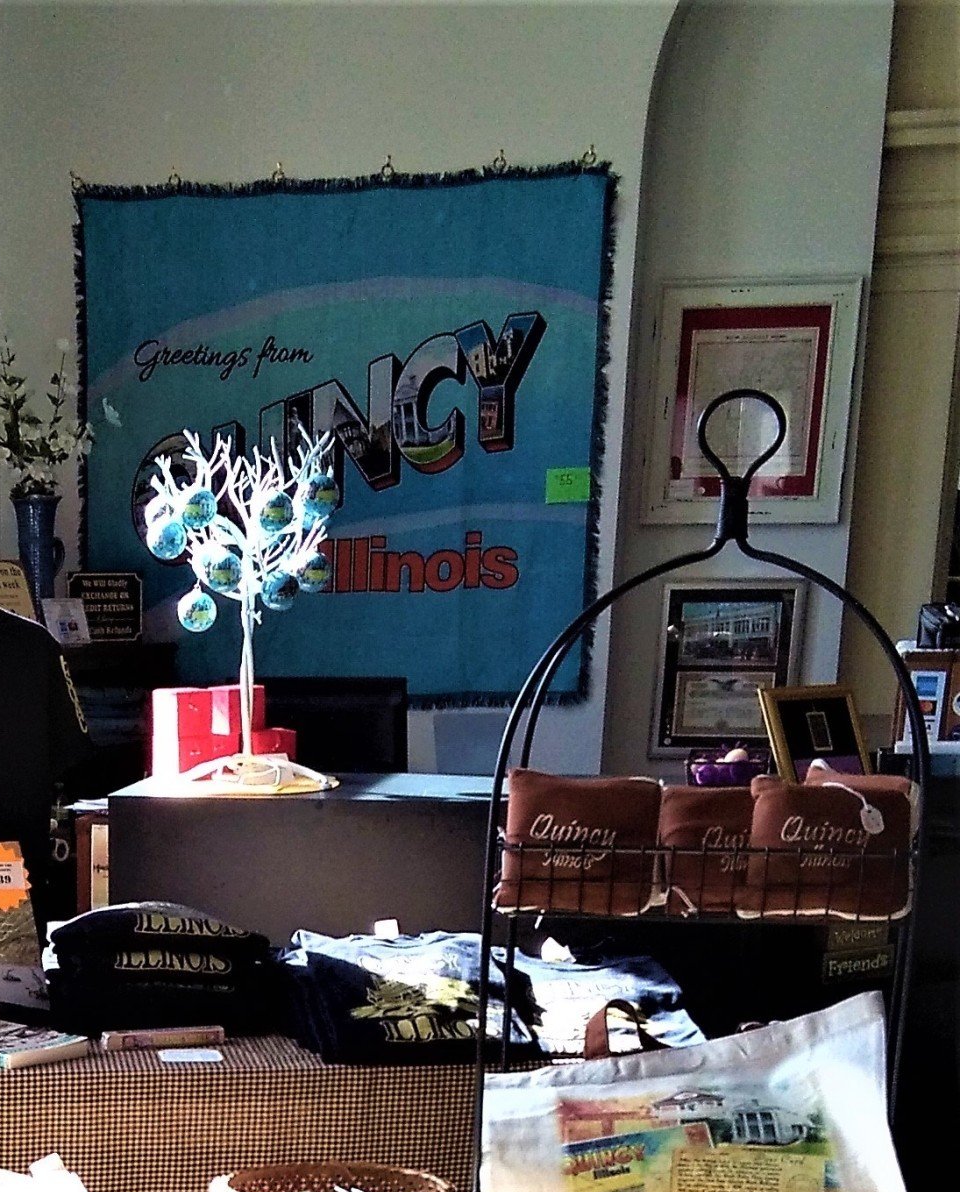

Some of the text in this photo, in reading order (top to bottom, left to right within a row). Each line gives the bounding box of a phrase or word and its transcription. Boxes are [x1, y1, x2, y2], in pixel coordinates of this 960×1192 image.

[134, 335, 314, 383] Greetings from
[84, 604, 102, 612] EDIT
[530, 813, 617, 852] Quincy
[780, 815, 871, 848] Quincy
[114, 950, 233, 975] ILLINOIS
[828, 953, 889, 977] Friends
[562, 1144, 646, 1177] QUINCY
